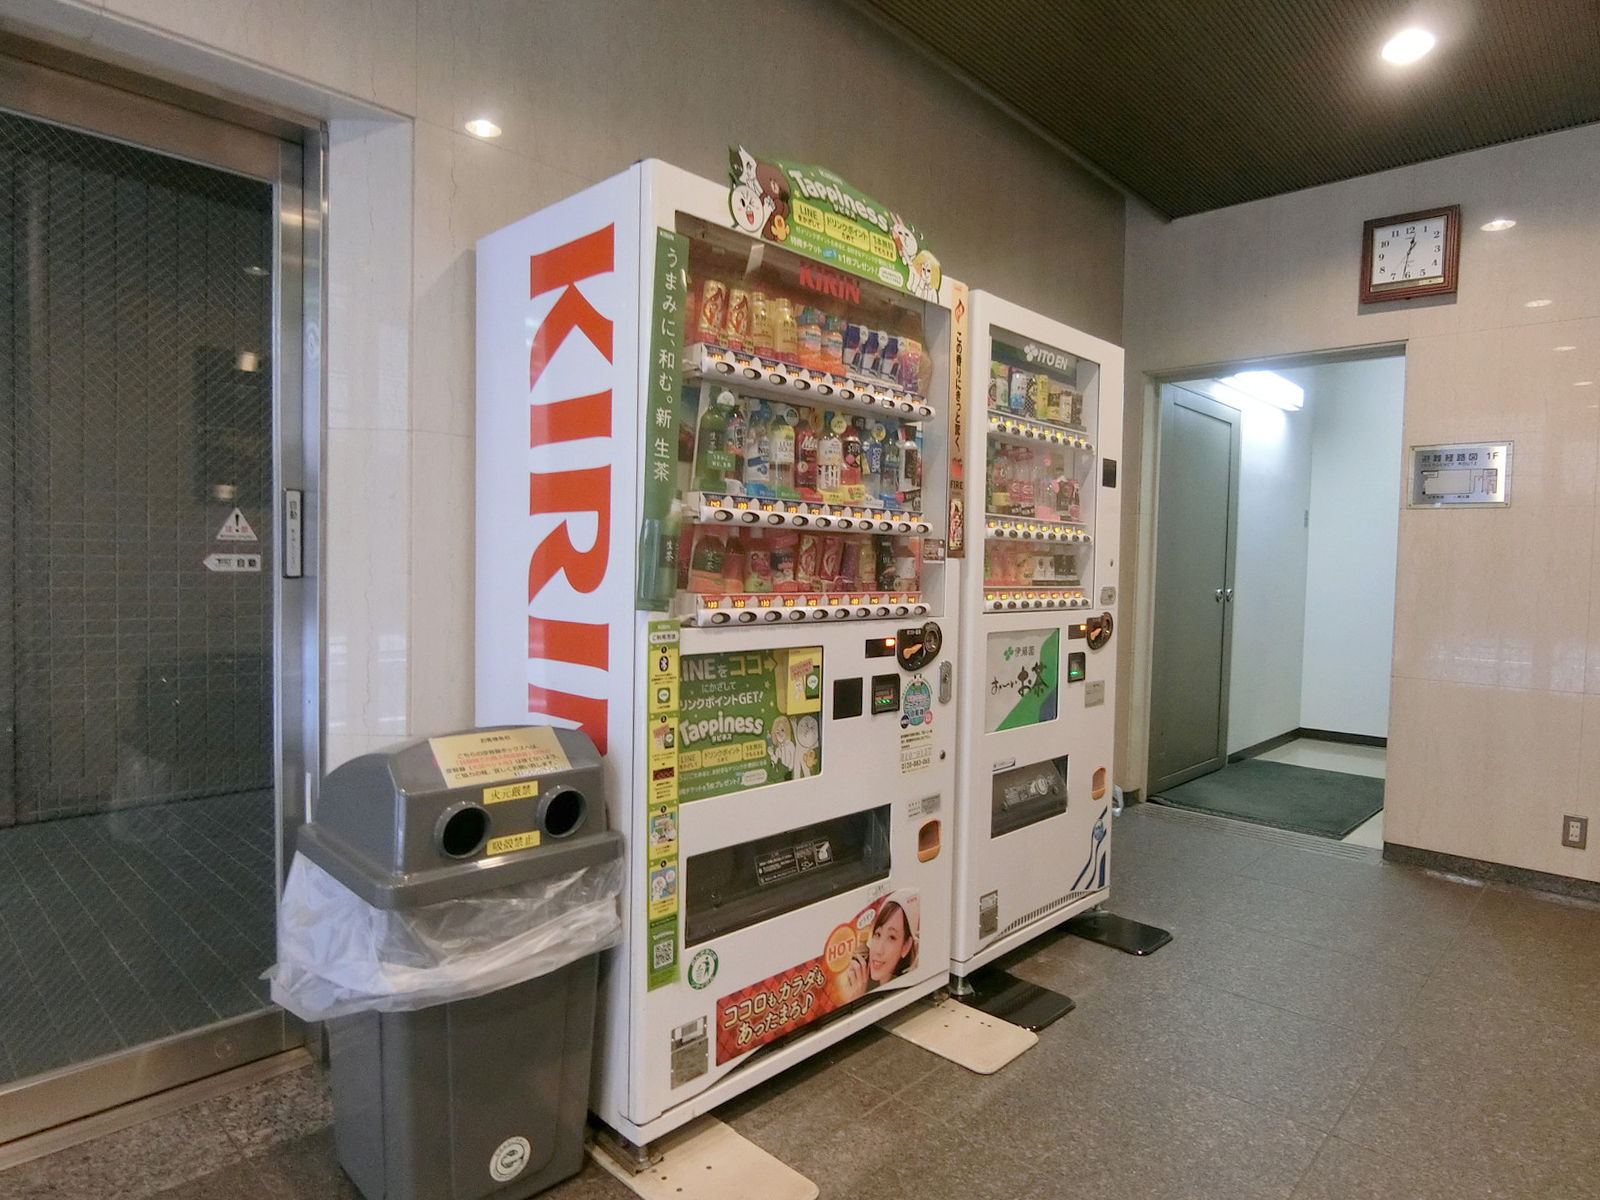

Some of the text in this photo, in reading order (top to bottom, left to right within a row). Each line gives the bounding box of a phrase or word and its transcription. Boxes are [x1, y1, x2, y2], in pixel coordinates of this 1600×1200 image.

[788, 169, 890, 233] Tappiness
[799, 205, 818, 221] LINE
[1391, 230, 1400, 238] 11
[1405, 226, 1416, 235] 12
[1423, 225, 1428, 233] 1
[1433, 230, 1440, 239] 2
[1380, 240, 1390, 249] 10
[1434, 245, 1441, 253] 3
[1378, 253, 1385, 261] 9
[1379, 266, 1386, 274] 8
[1404, 271, 1411, 279] 6
[1419, 268, 1426, 277] 5
[799, 263, 860, 304] KIRIN
[1037, 348, 1069, 371] ITO EN
[1486, 451, 1500, 460] 1F
[950, 479, 964, 490] FIRE
[1013, 645, 1035, 658] 伊藤園
[679, 654, 764, 683] INEをココ
[701, 681, 737, 694] にかざして
[679, 711, 764, 746] Tappiness
[490, 784, 532, 800] 火元厳禁
[492, 836, 534, 852] 吸殻禁止
[828, 938, 854, 961] HOT
[723, 965, 826, 1029] ココロもカラダも
